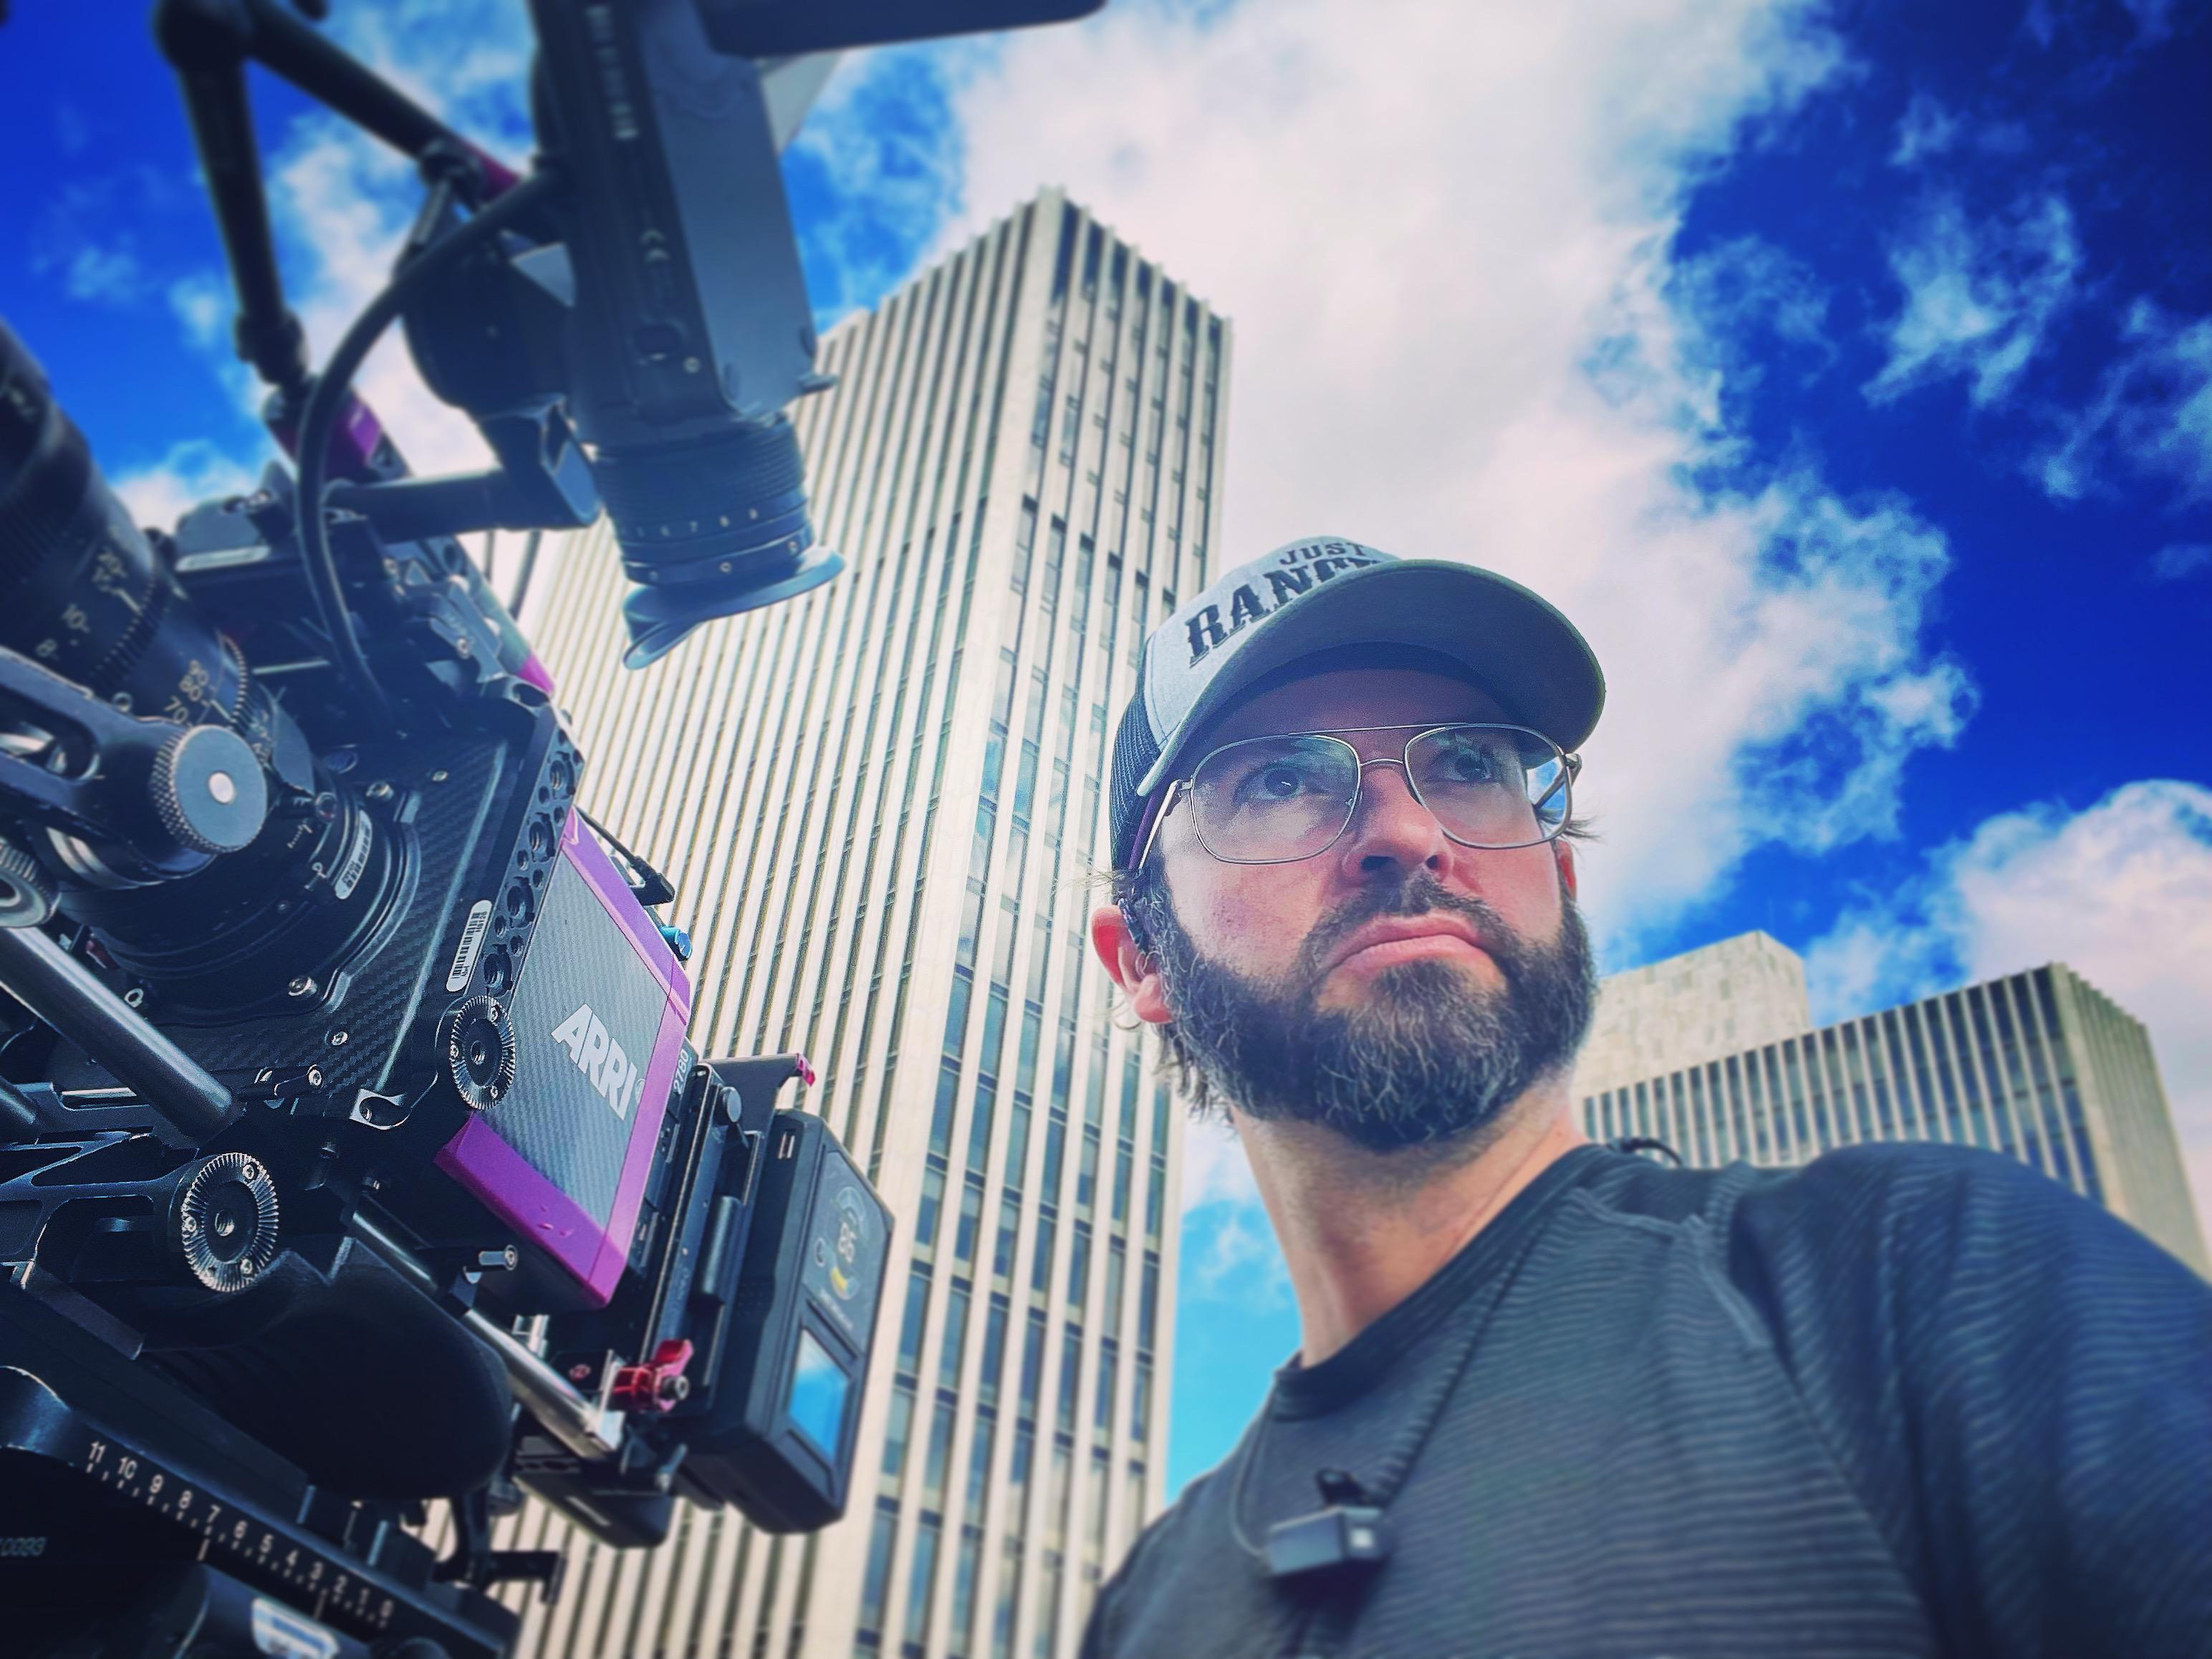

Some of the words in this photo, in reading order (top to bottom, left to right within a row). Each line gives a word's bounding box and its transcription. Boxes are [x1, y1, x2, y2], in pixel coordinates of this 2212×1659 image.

[1279, 542, 1366, 565] JUST
[1185, 557, 1382, 668] RAN
[35, 638, 57, 658] 8
[179, 674, 203, 702] 80
[163, 695, 189, 724] 70
[551, 1004, 638, 1121] ARRI
[673, 1048, 690, 1095] 2780
[89, 1441, 106, 1463] 11
[117, 1457, 138, 1479] 10
[150, 1474, 164, 1494] 9
[179, 1490, 193, 1509] 8
[207, 1505, 221, 1524] 7
[234, 1520, 248, 1539] 6
[260, 1534, 274, 1554] 5
[287, 1549, 299, 1567] 4
[334, 1575, 347, 1595] 2
